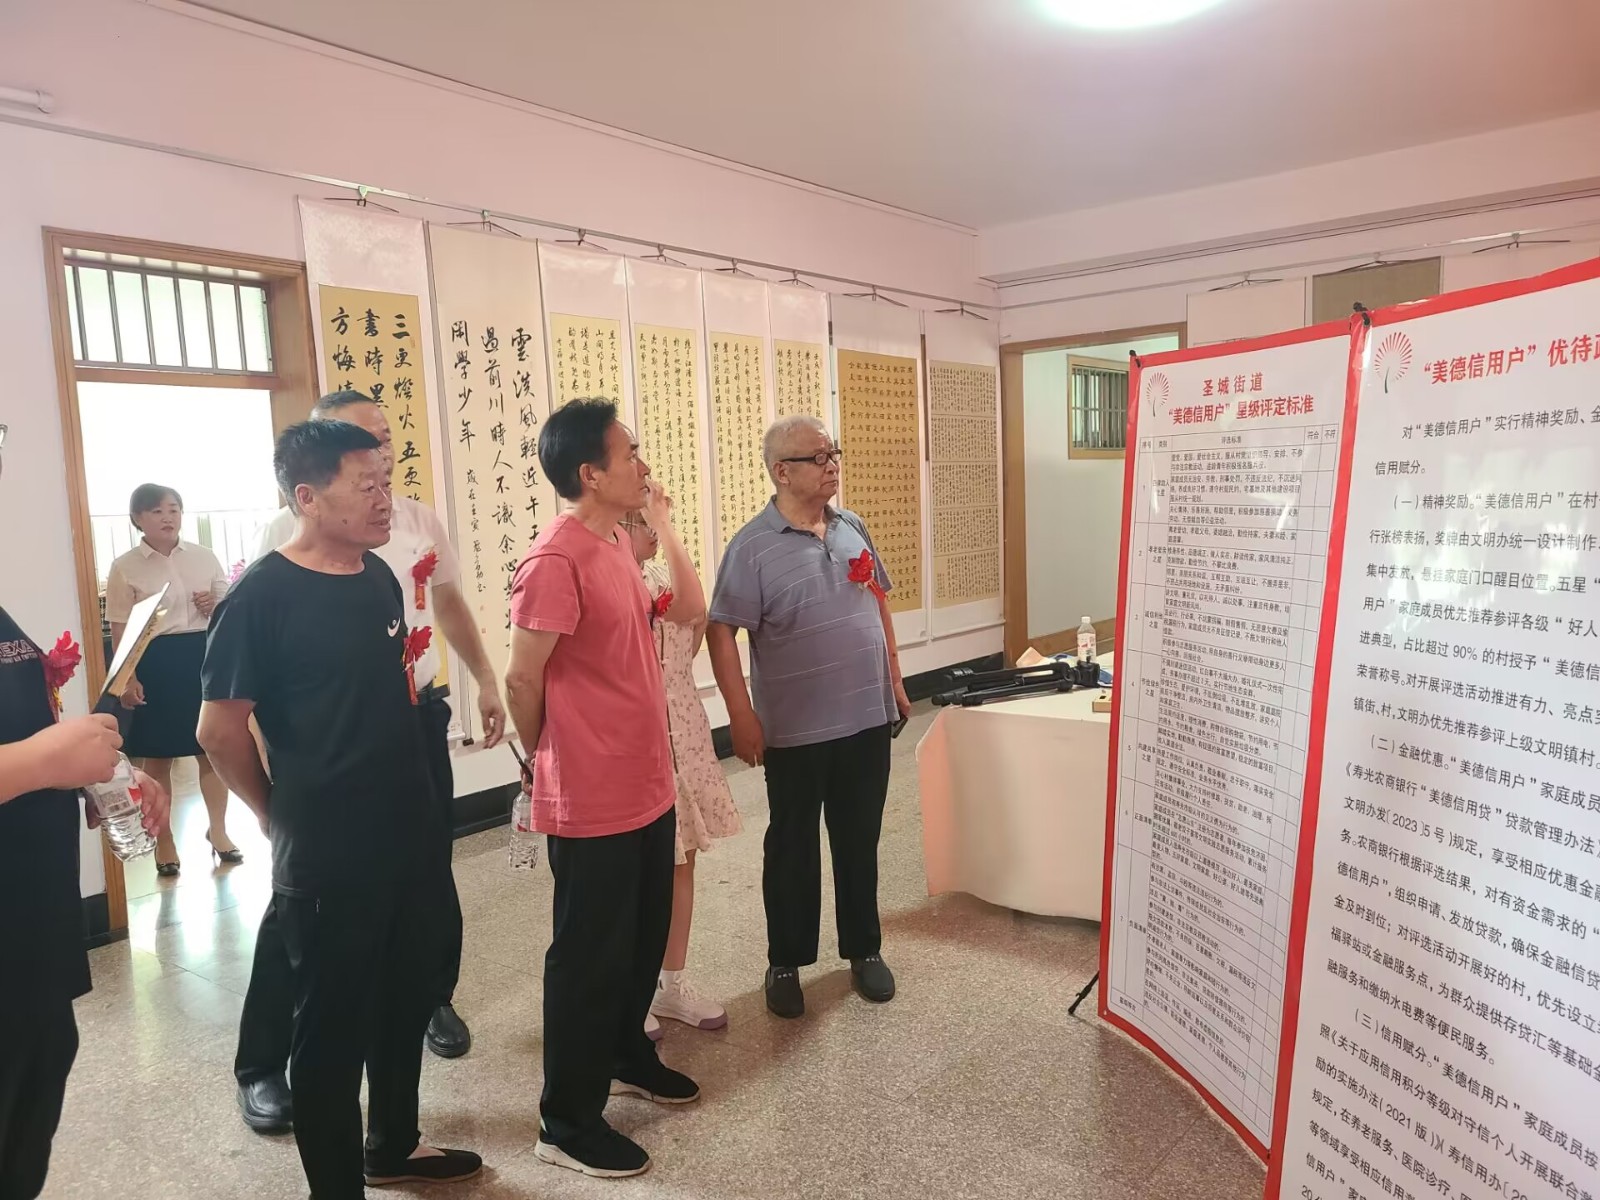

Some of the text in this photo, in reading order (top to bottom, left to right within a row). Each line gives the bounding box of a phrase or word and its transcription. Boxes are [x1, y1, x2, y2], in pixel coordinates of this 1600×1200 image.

[1203, 372, 1264, 397] 圣城街道
[1375, 460, 1426, 475] 信用赋分。
[1334, 894, 1600, 1035] 金及时到位；对评选活动开展好的村，优先设立
